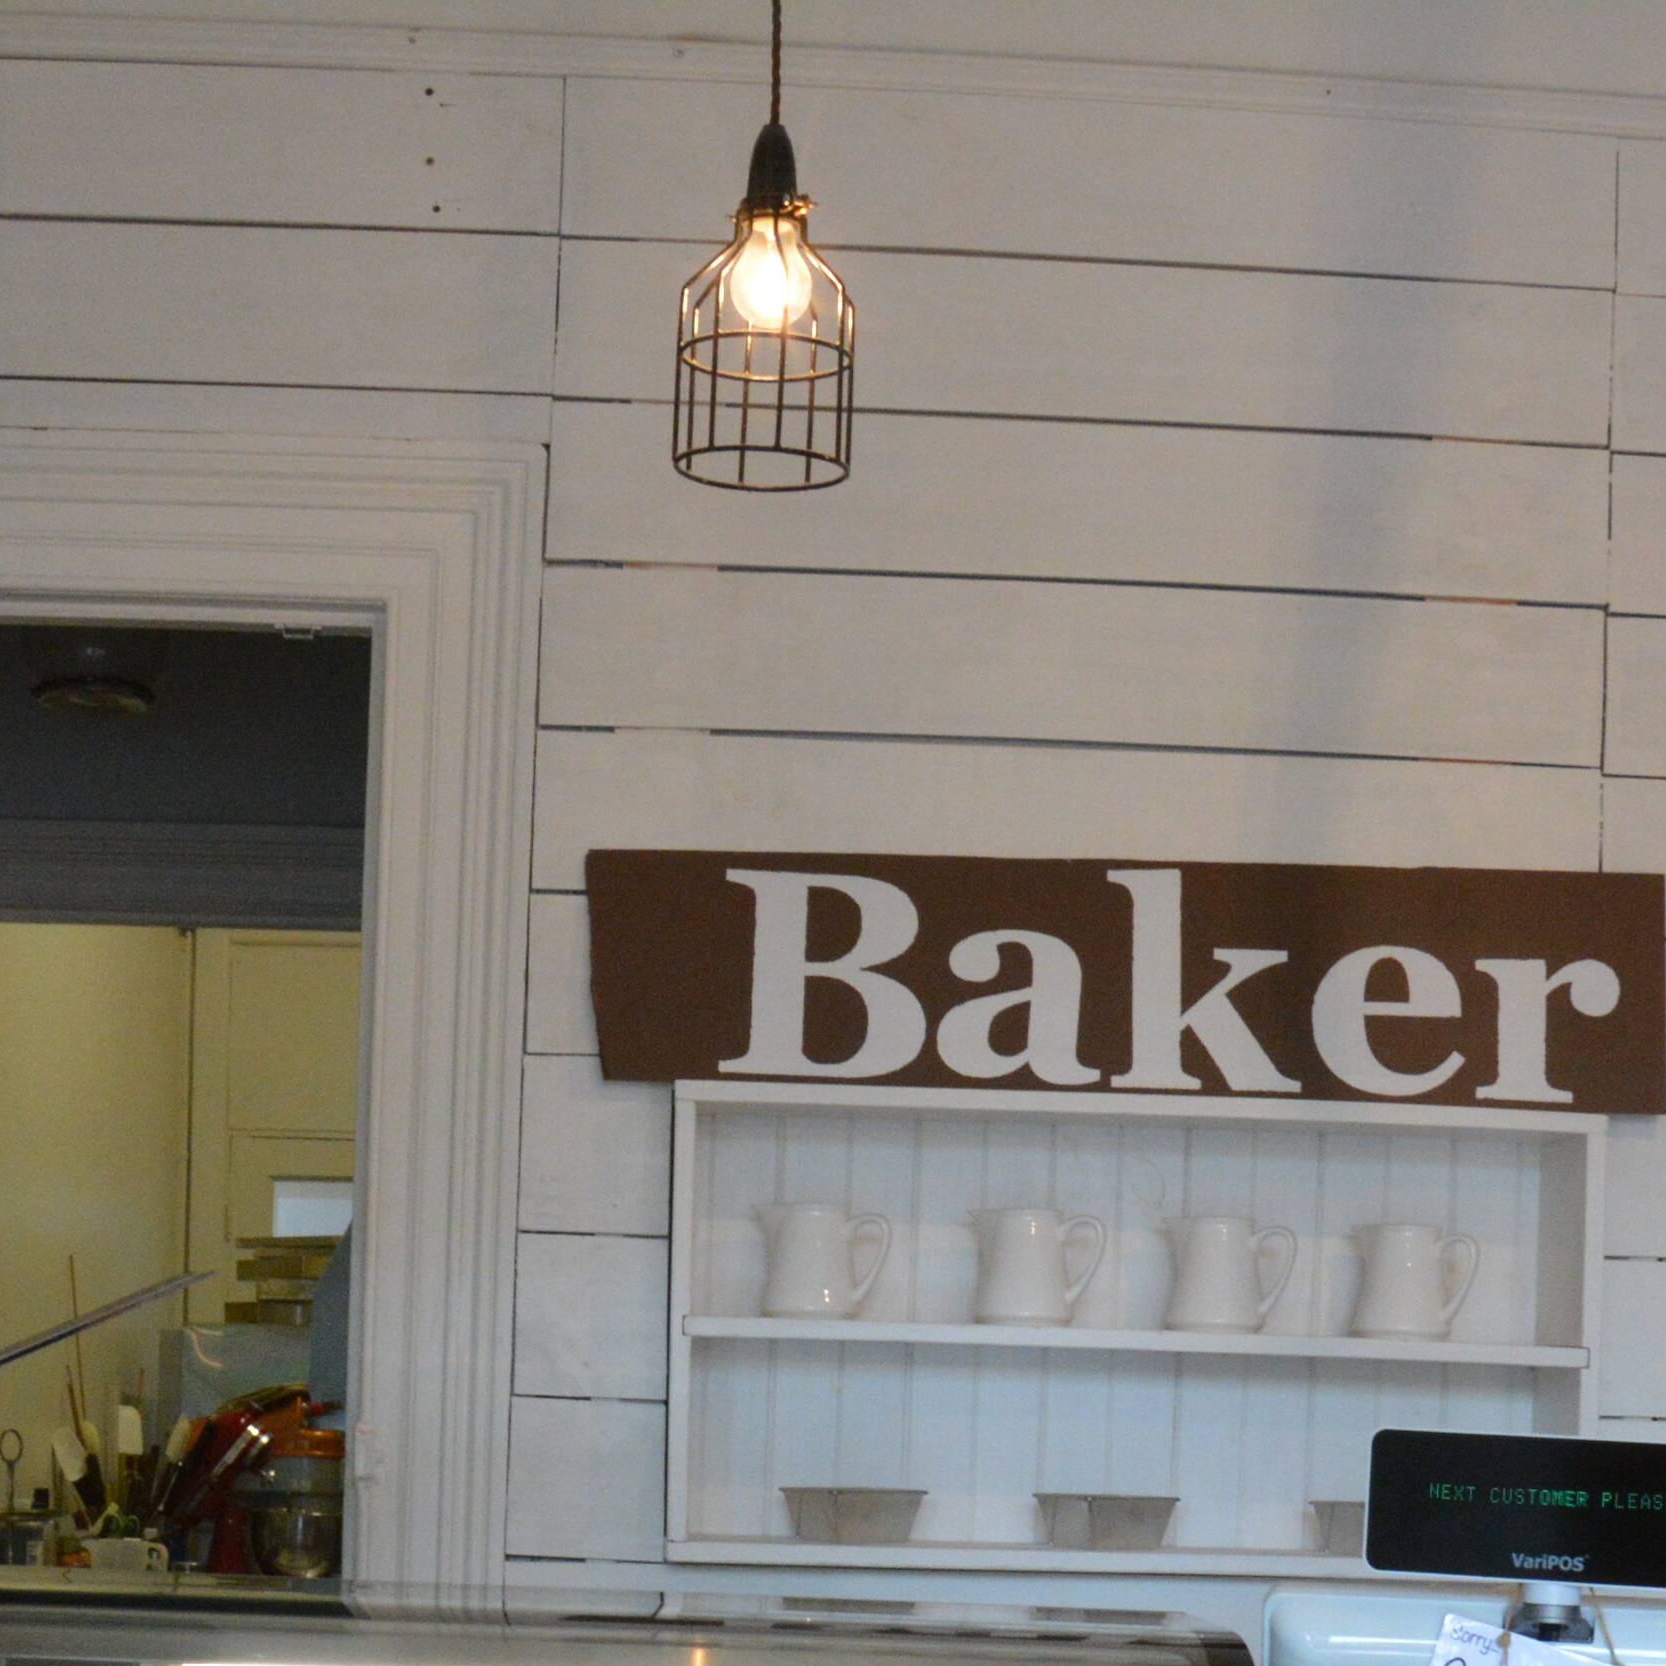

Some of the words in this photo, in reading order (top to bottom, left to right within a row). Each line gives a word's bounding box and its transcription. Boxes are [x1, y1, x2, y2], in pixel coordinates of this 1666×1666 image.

[718, 868, 1621, 1103] Baker
[1429, 1482, 1477, 1501] NEXT
[1489, 1487, 1590, 1508] CUSTOMER
[1511, 1552, 1586, 1573] VariPOS
